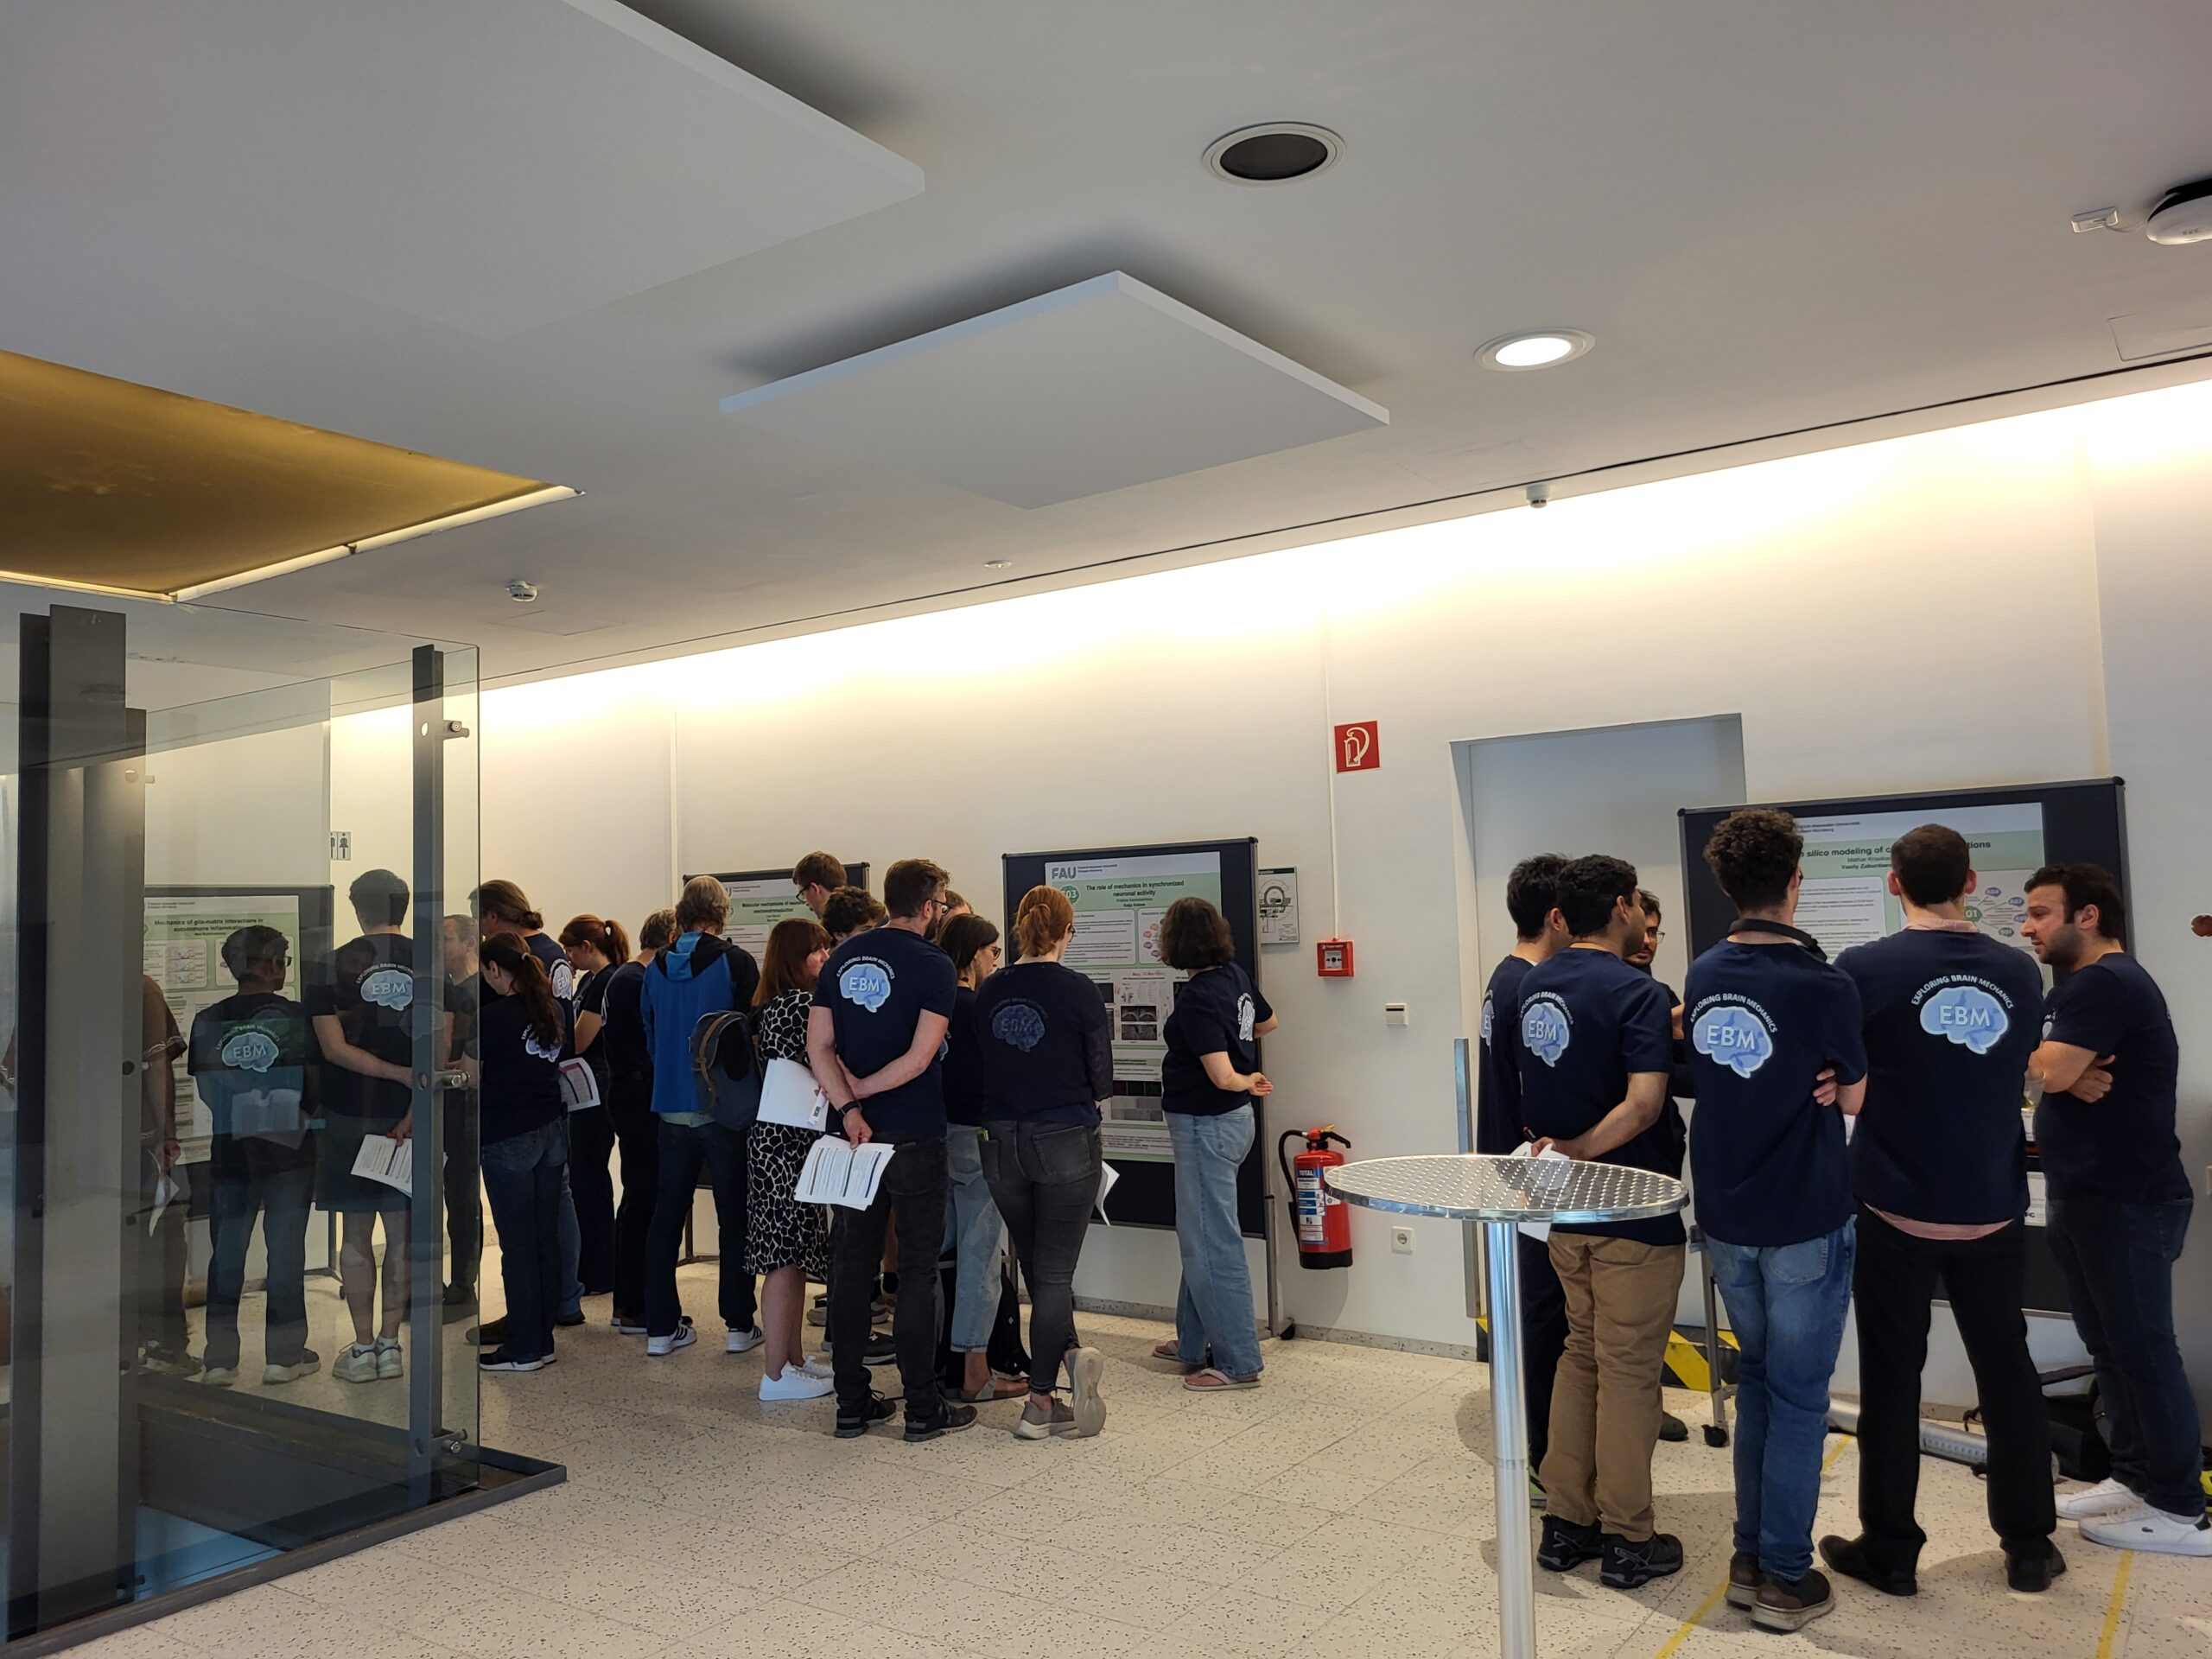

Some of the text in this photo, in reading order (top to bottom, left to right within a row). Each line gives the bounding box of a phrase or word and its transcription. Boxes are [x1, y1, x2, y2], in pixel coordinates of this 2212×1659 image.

[1831, 847, 1872, 856] modeling
[1051, 866, 1077, 880] FAU
[1148, 880, 1185, 889] synchronized
[372, 982, 407, 995] EBM
[849, 976, 880, 992] EBM
[1910, 974, 2014, 1009] EXPLORING BRAIN MECHANICS
[1689, 993, 1778, 1033] EXPLORING BRAIN MECHANICS
[1939, 1005, 1991, 1027] EBM
[1001, 1018, 1033, 1032] EBM
[1528, 1020, 1557, 1041] EBM
[1707, 1024, 1756, 1051] EBM
[232, 1043, 267, 1059] EBM
